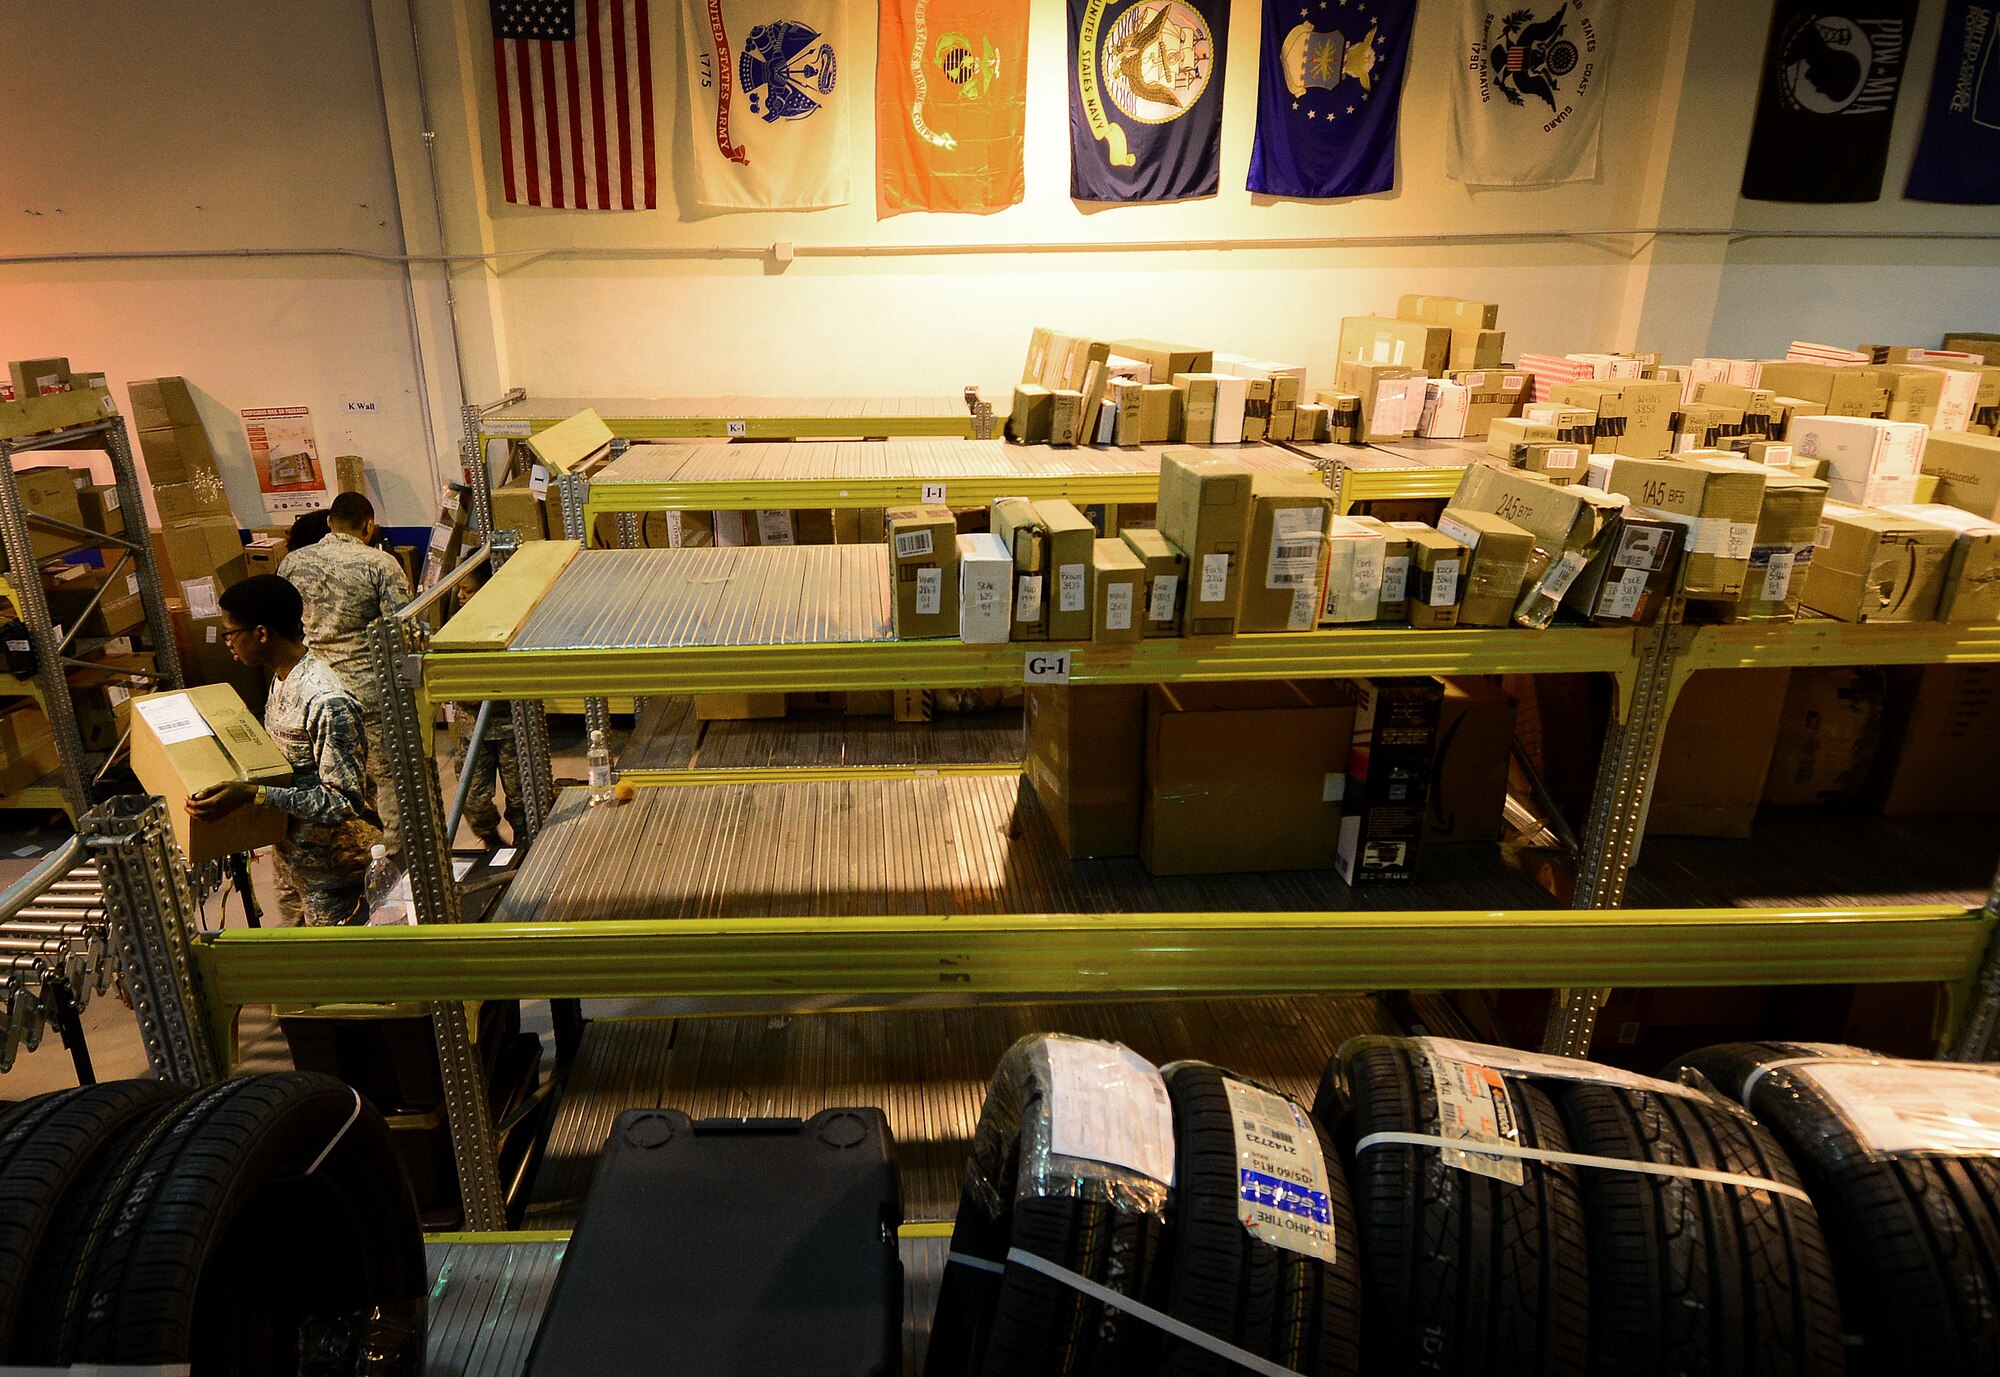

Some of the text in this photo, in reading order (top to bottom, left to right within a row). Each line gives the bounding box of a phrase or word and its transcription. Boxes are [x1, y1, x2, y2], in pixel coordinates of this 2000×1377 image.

[1965, 8, 1991, 62] UNITED
[1081, 0, 1104, 129] UNITED STATES NAVY
[1469, 42, 1481, 70] 1790
[1841, 19, 1904, 115] POW MIA
[700, 53, 712, 88] 1775
[709, 0, 730, 149] NITED STATES ARMY
[911, 0, 936, 141] TED STATES MARINE CORPS
[1479, 59, 1491, 103] PARATUS
[1543, 18, 1596, 132] STATES COAST GUARD
[730, 424, 745, 432] K-1
[1920, 464, 1981, 485] llen Edmonds
[926, 487, 943, 498] I-1
[1495, 493, 1521, 520] 2A5
[1642, 480, 1667, 506] 1A5
[1029, 658, 1067, 675] G-1
[1246, 1133, 1297, 1155] 2142723
[1257, 1210, 1284, 1228] TIRE
